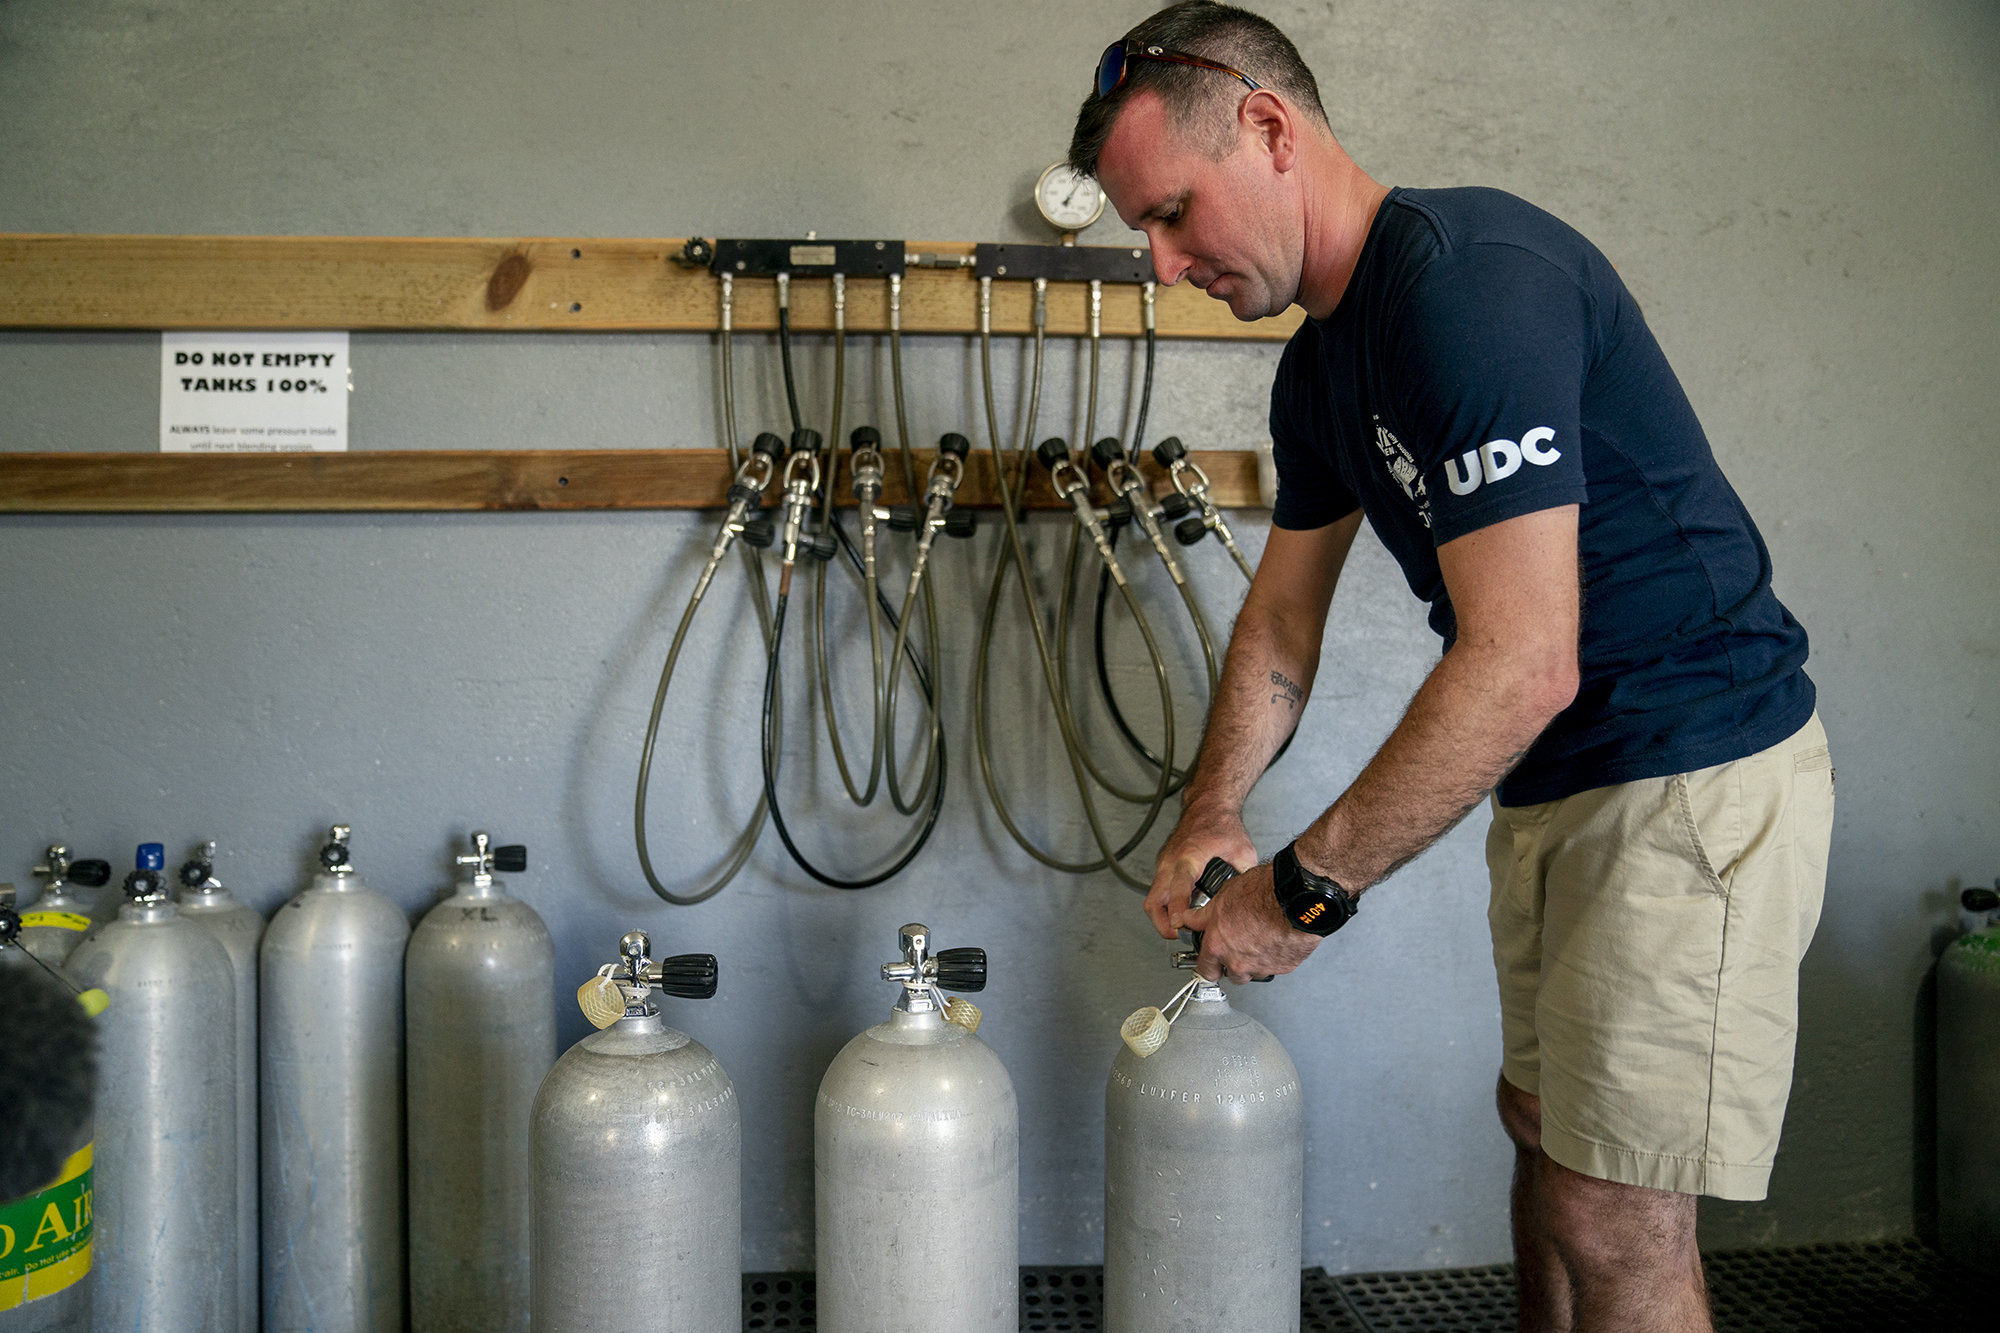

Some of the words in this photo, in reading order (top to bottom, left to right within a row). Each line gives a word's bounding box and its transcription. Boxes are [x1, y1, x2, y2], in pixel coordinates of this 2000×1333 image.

[175, 353, 203, 365] DO
[212, 353, 254, 366] NOT
[262, 353, 334, 367] EMPTY
[181, 378, 256, 391] TANKS
[267, 379, 327, 393] 100%
[169, 426, 210, 435] ALWAYS
[213, 426, 237, 435] leave
[267, 428, 306, 436] pressure
[309, 426, 337, 435] inside
[190, 442, 212, 450] until
[237, 442, 276, 452] blending
[1444, 426, 1562, 496] UDC
[460, 907, 499, 922] XL
[1305, 902, 1326, 919] 4:01
[1140, 1083, 1201, 1103] LUXFER
[1217, 1091, 1265, 1104] 12A05
[24, 1189, 93, 1253] AIR
